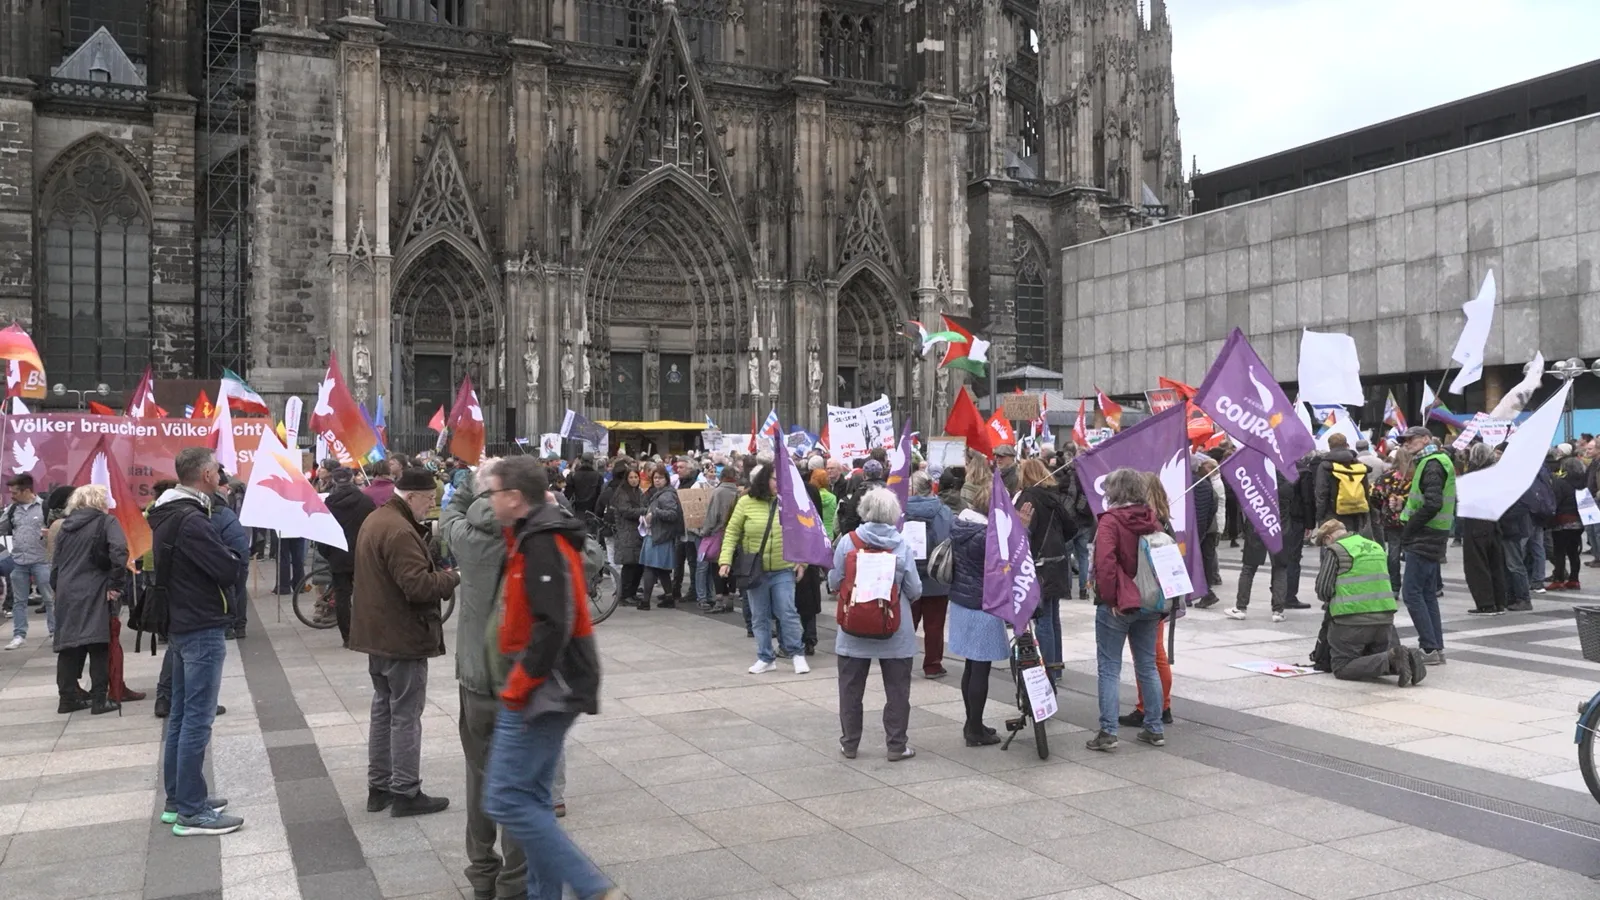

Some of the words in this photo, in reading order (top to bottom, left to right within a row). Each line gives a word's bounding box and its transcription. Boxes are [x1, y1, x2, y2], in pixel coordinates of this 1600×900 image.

[10, 418, 75, 433] Völker
[81, 418, 157, 436] brauchen
[323, 429, 353, 463] BSW
[1235, 466, 1281, 537] COURAGE
